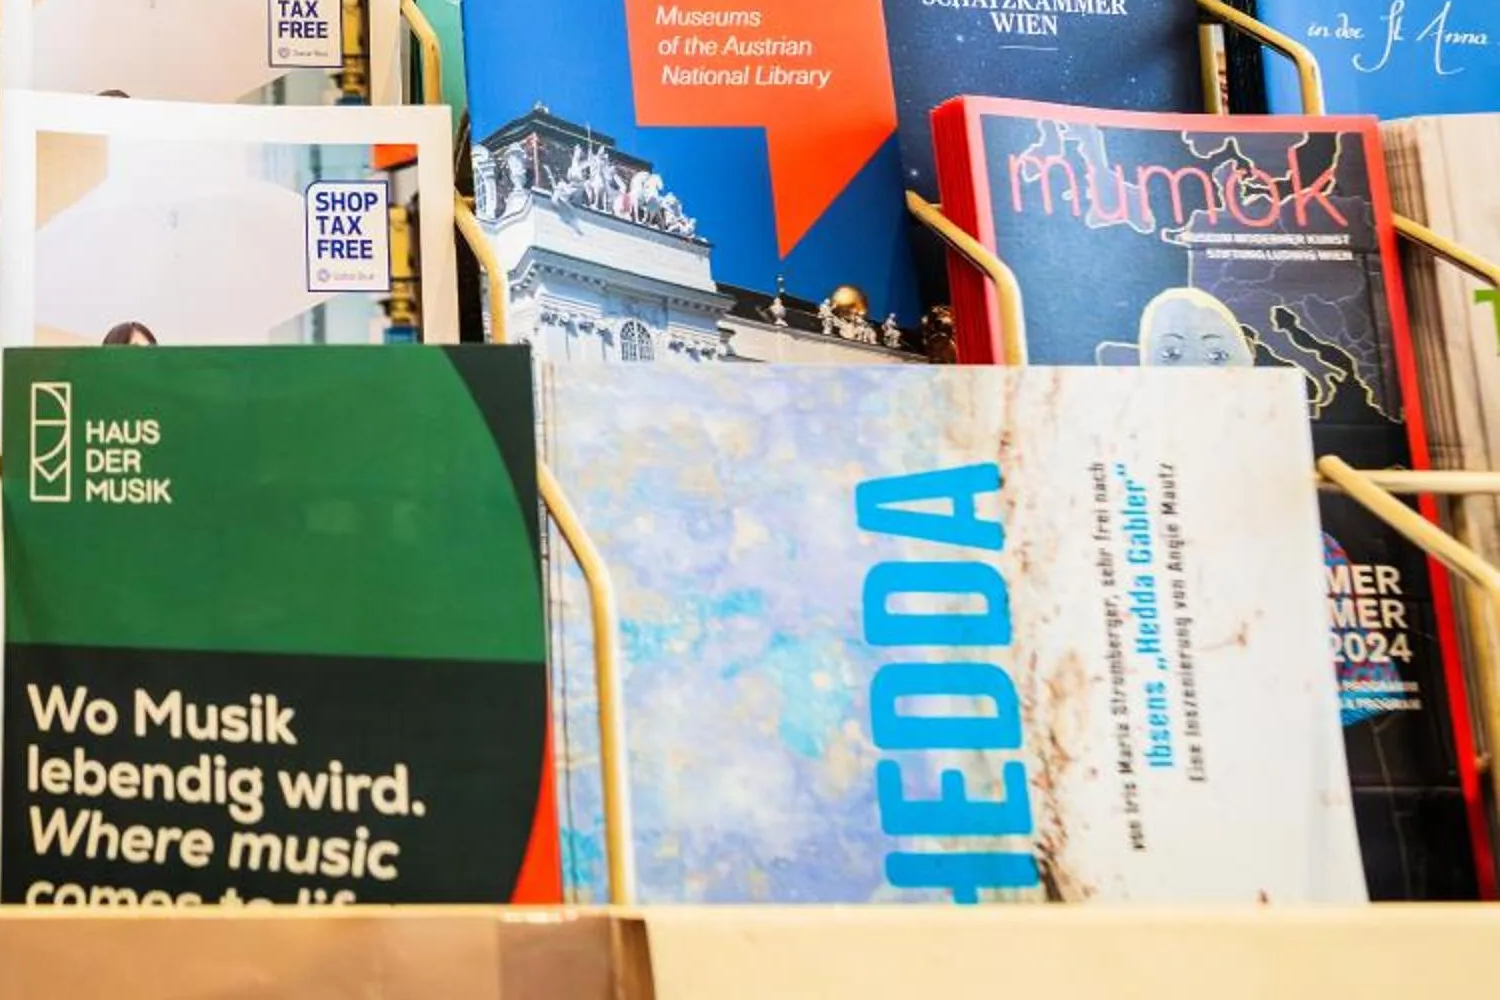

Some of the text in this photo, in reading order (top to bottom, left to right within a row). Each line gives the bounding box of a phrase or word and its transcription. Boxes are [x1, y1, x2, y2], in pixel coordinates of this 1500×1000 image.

[277, 0, 319, 18] TAX
[655, 5, 762, 28] Museums
[277, 21, 329, 40] FREE
[990, 11, 1059, 36] WIEN
[657, 33, 813, 57] of the Austrian
[661, 64, 832, 90] National Library
[1007, 146, 1349, 228] mumok
[315, 191, 378, 212] SHOP
[315, 215, 363, 236] TAX
[316, 239, 374, 260] FREE
[84, 419, 161, 445] HAUS
[84, 448, 142, 473] DER
[84, 478, 173, 504] MUSIK
[1087, 462, 1108, 503] nach
[1091, 508, 1112, 540] frei
[1096, 547, 1116, 587] sehr
[26, 683, 299, 746] Wo Musik
[1143, 680, 1174, 767] Ibsens
[27, 745, 427, 825] lebendig wird.
[28, 803, 400, 880] Where music
